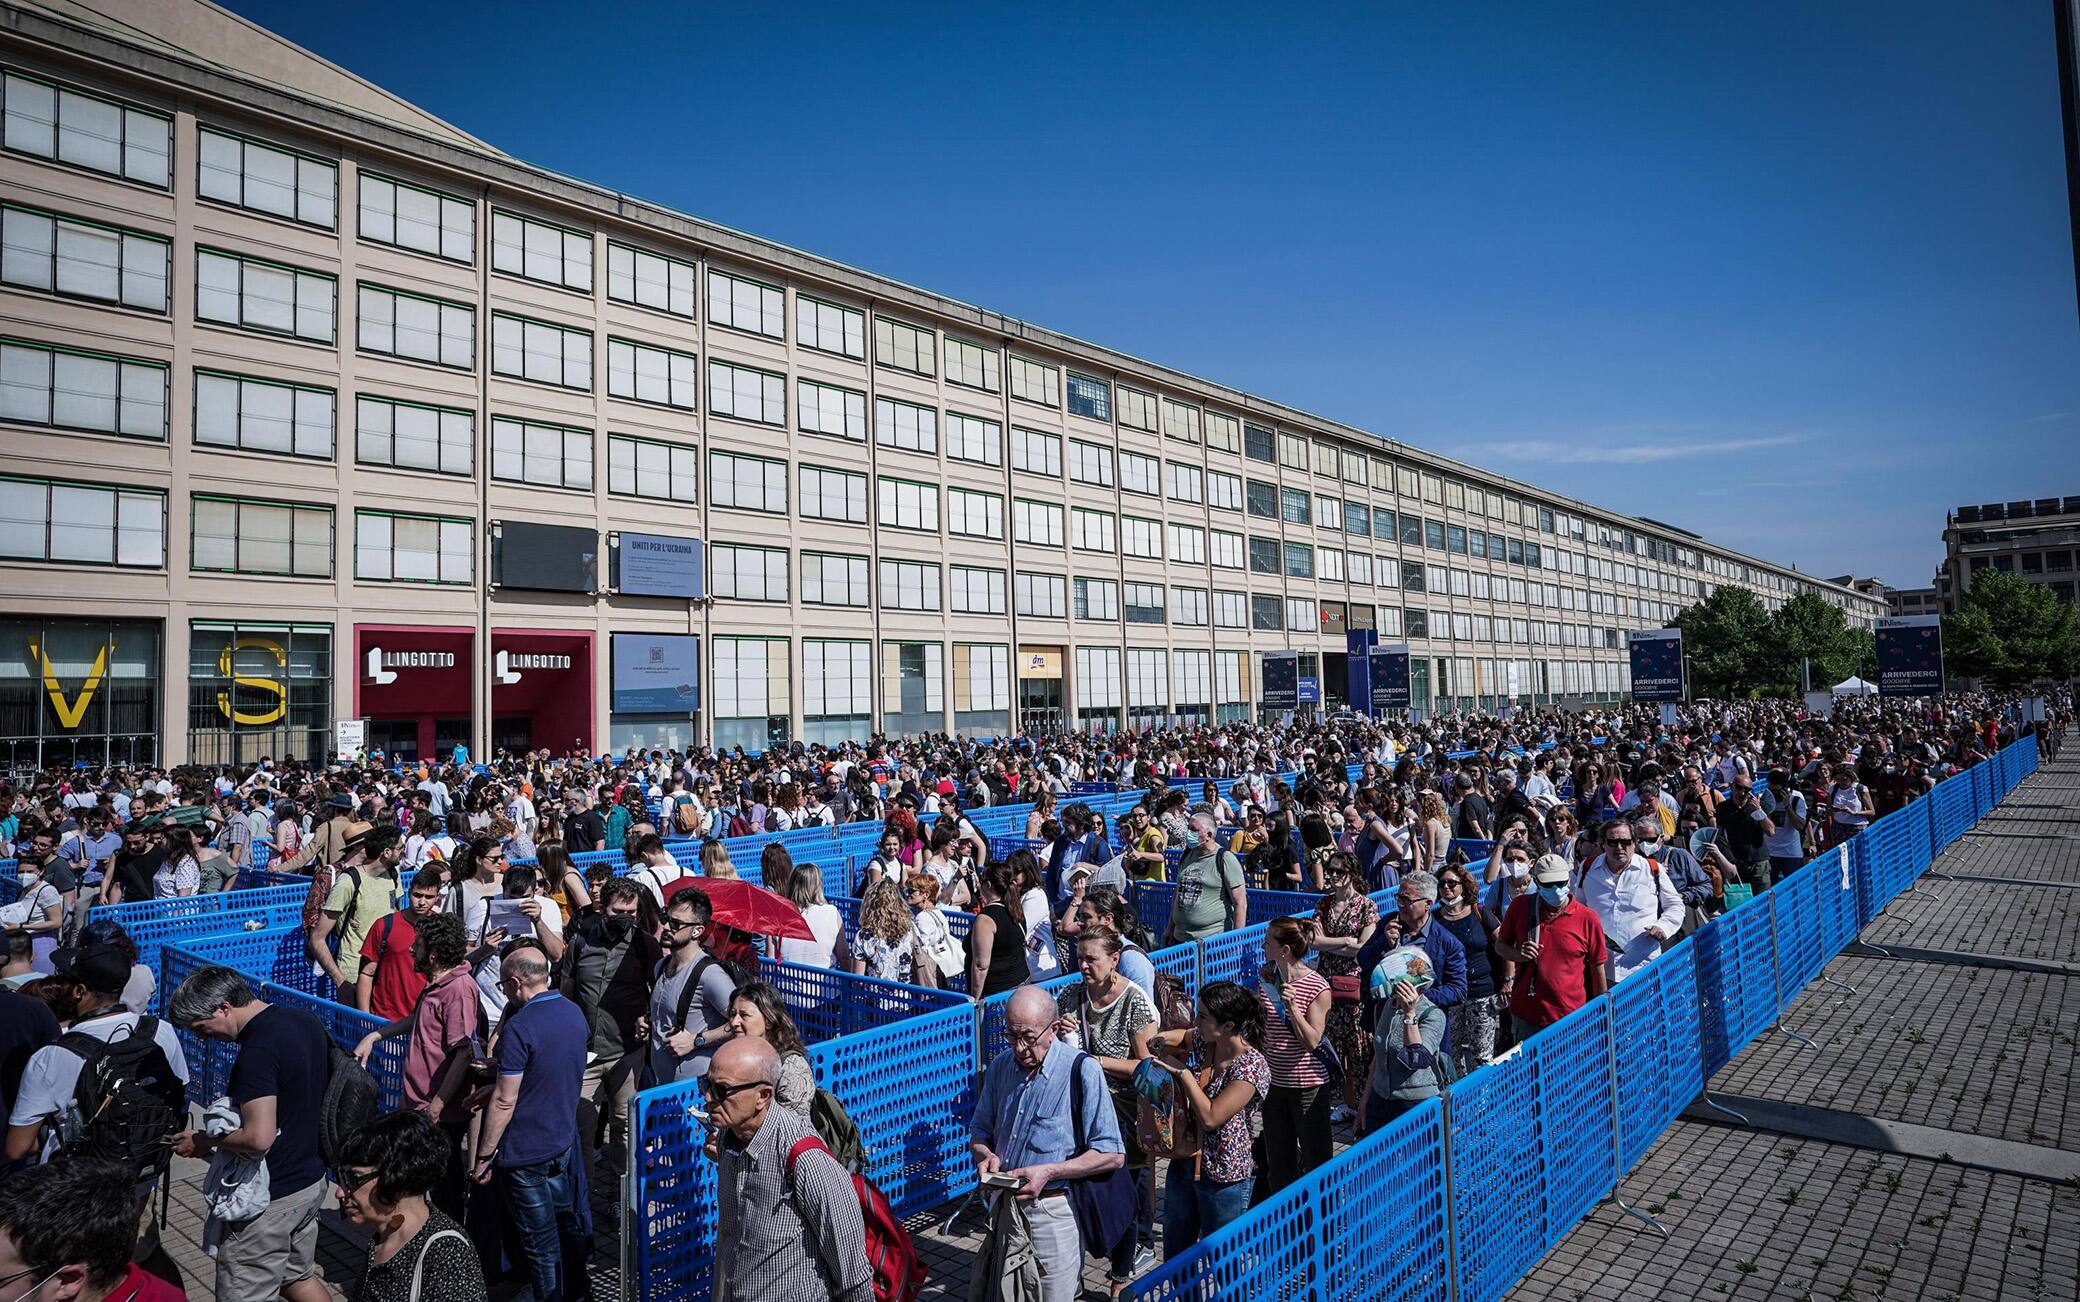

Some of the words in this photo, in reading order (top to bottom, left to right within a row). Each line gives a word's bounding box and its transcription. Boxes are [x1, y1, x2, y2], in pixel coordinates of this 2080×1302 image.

[632, 541, 649, 550] UNITI
[650, 542, 661, 552] PER
[387, 651, 455, 667] LINGOTTO
[512, 654, 571, 669] LINGOTTO
[1032, 654, 1044, 665] dm
[1881, 670, 1937, 679] ARRIVEDERCI
